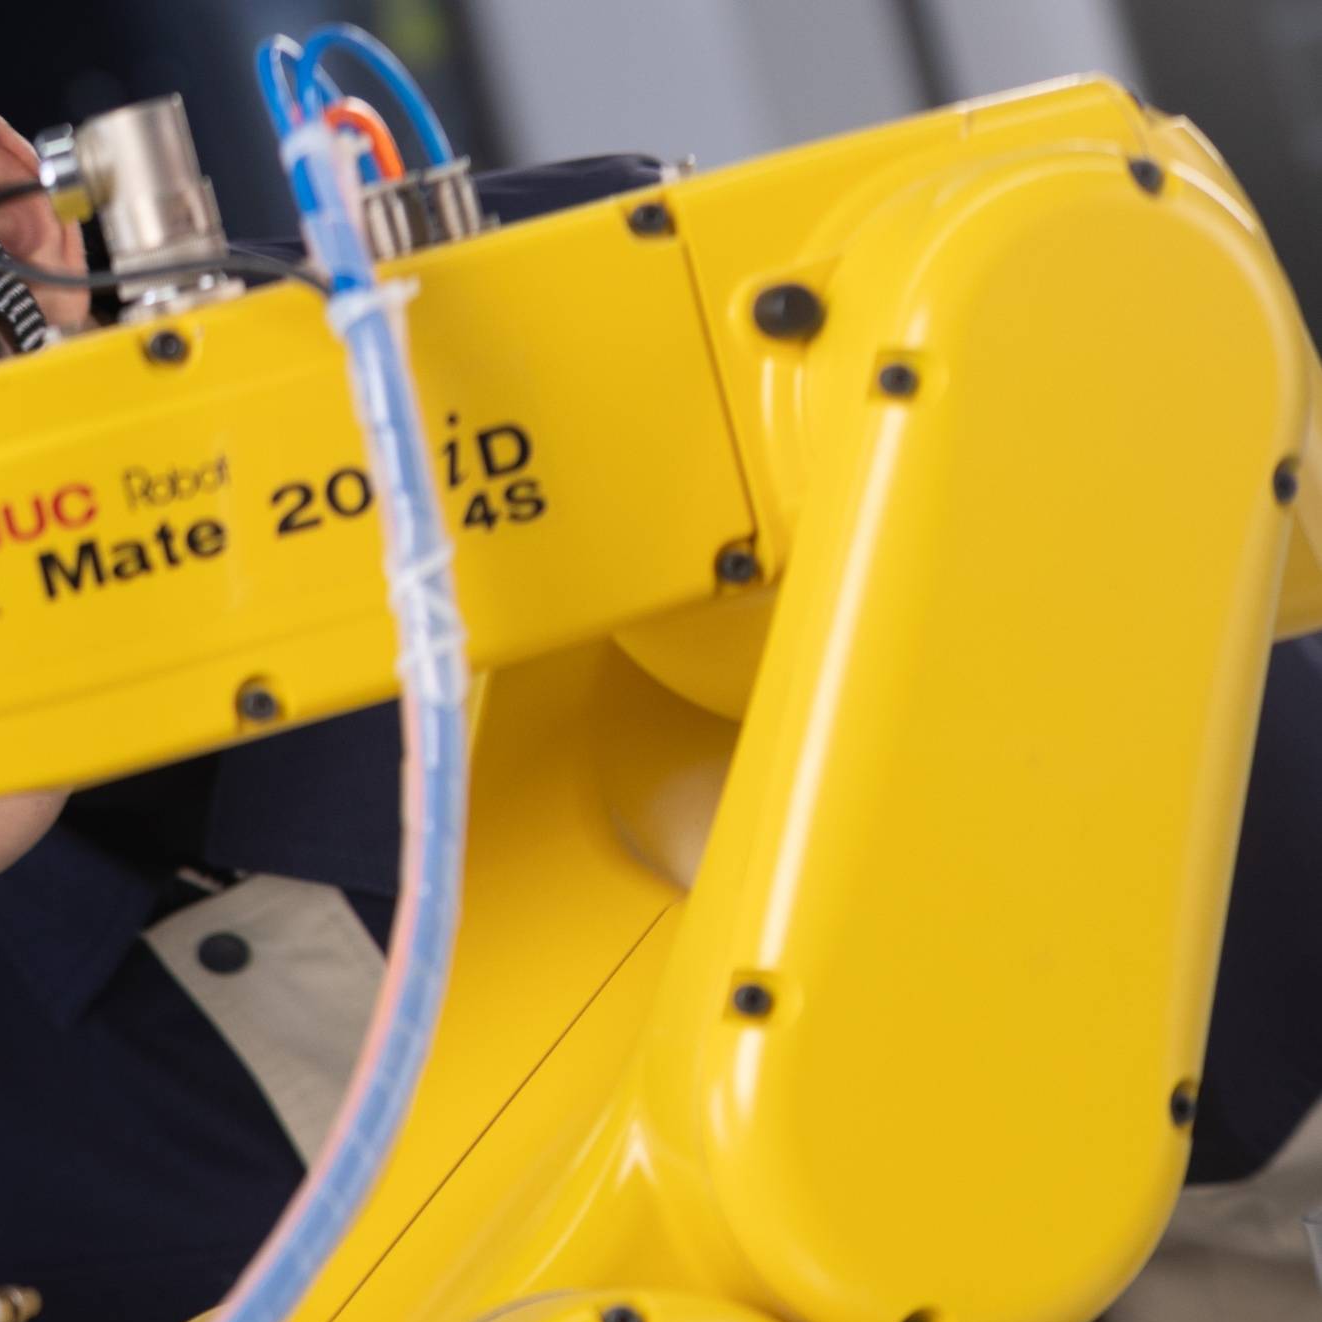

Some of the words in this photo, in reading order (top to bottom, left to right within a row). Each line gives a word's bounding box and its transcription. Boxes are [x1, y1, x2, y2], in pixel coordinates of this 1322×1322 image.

[37, 516, 227, 602] Mate
[270, 410, 532, 537] 20iD
[120, 453, 229, 513] Robot
[462, 477, 547, 533] 4S
